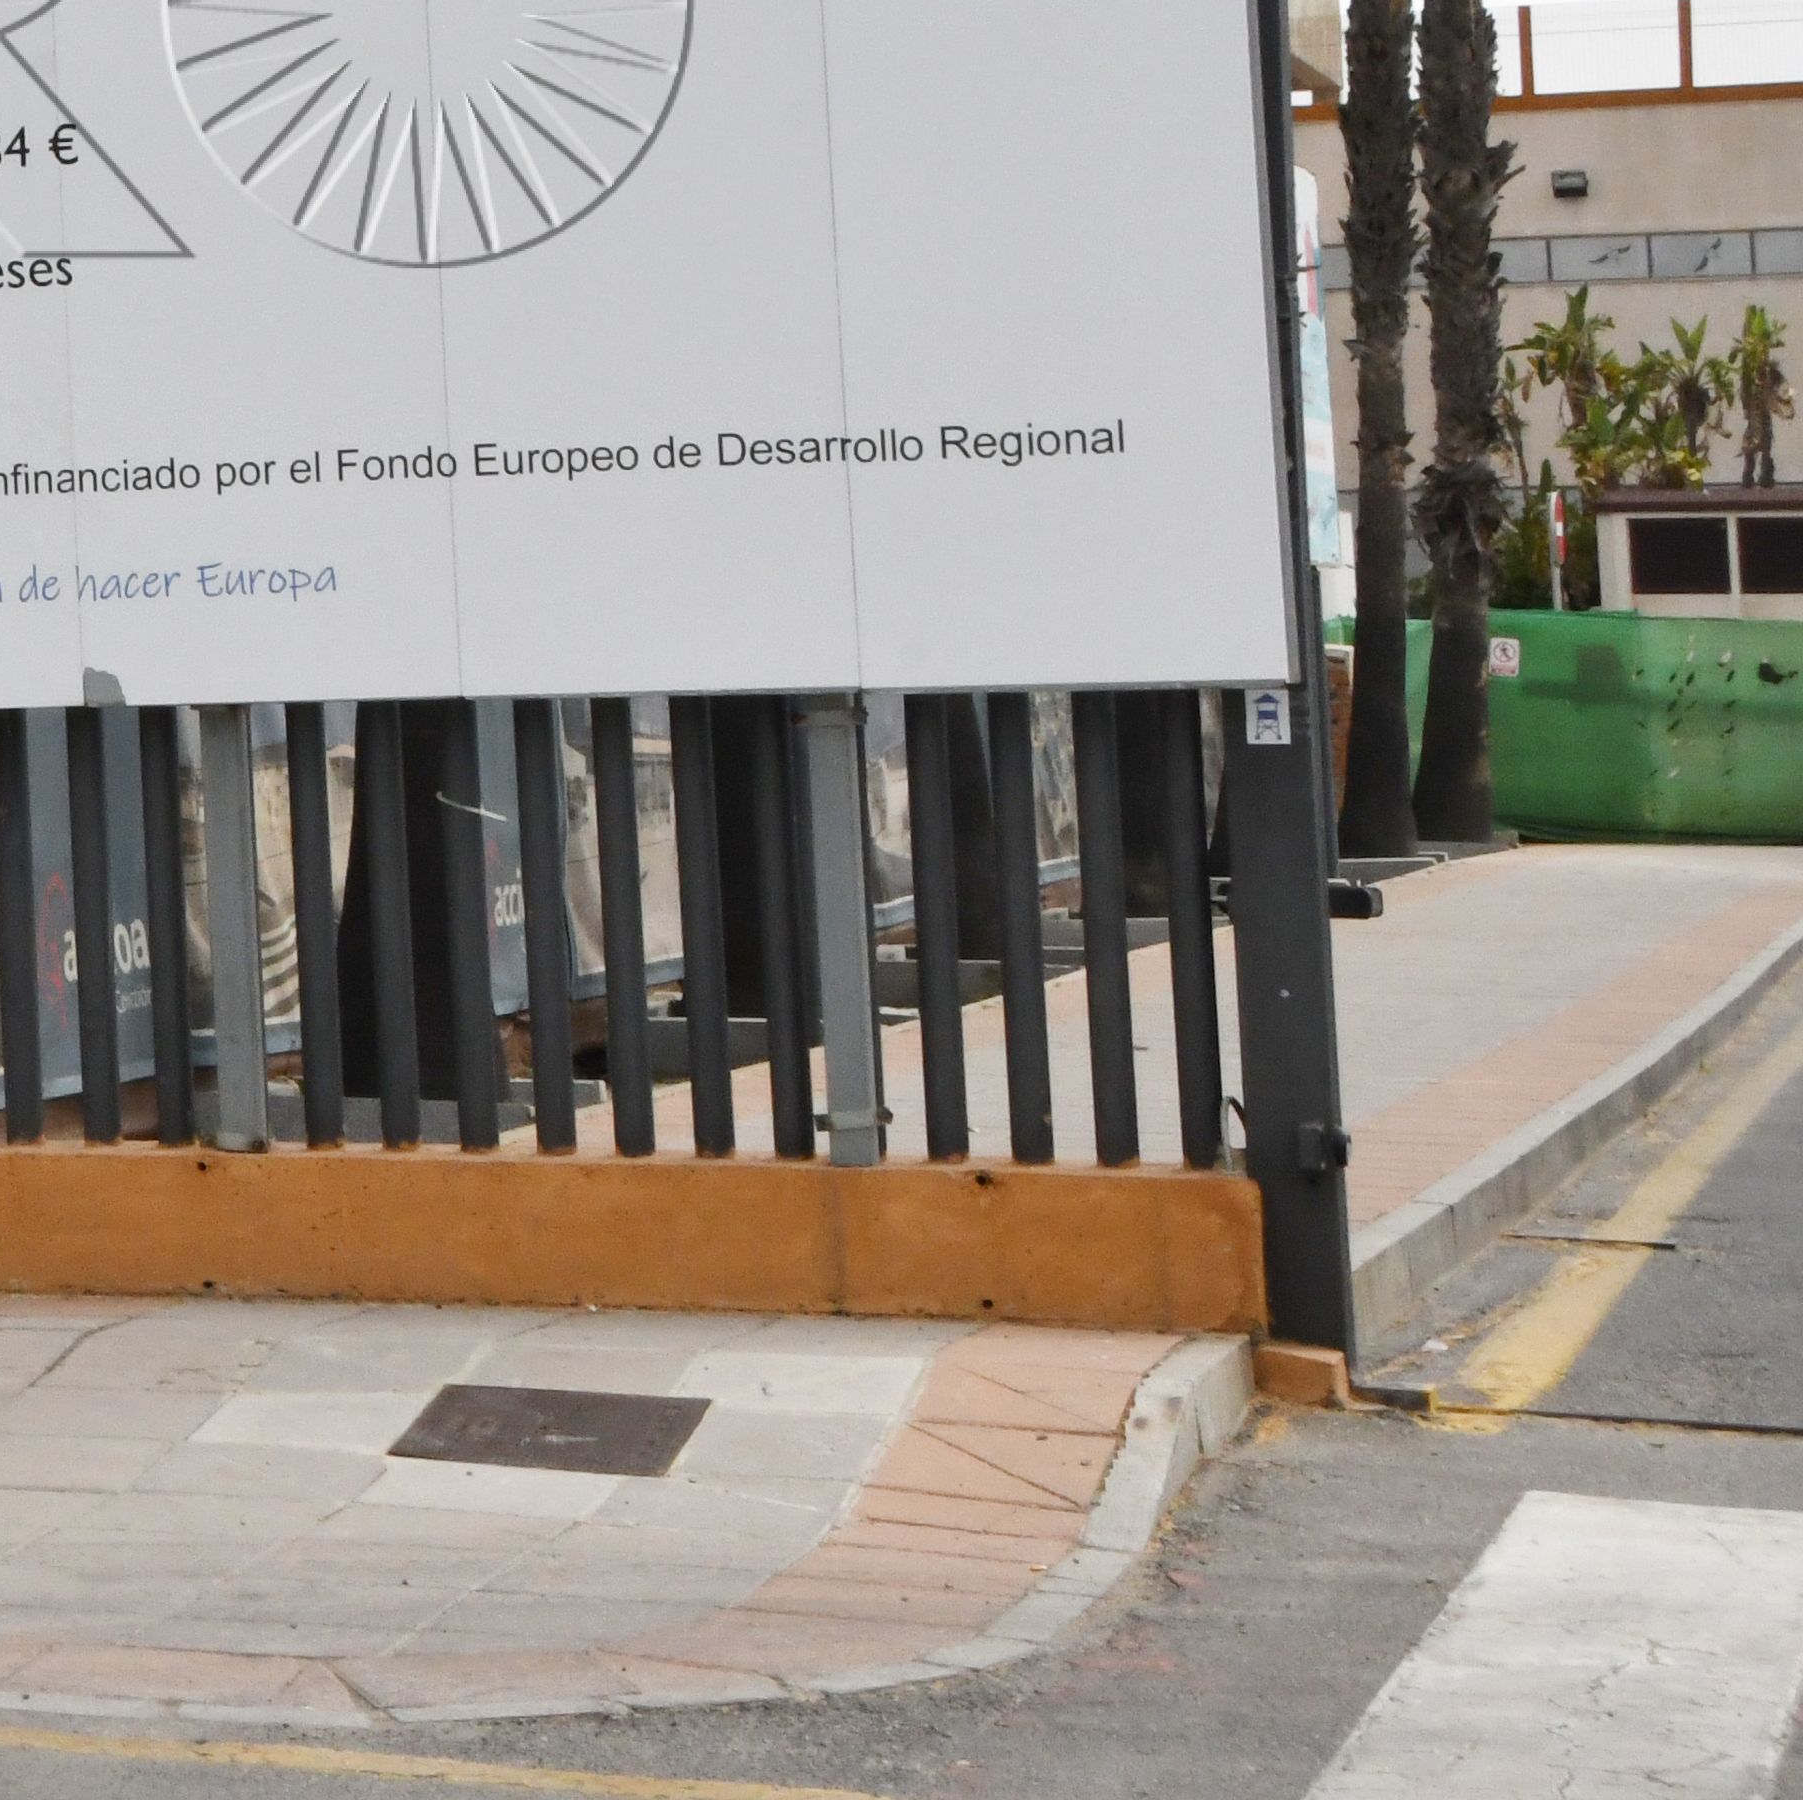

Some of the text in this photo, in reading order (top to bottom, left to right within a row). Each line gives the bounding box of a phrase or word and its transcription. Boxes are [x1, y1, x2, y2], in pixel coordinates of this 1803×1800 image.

[47, 123, 80, 165] €
[215, 455, 277, 495] por
[289, 451, 321, 484] el
[337, 445, 458, 483] Fondo
[473, 441, 640, 482] Europeo
[653, 435, 702, 469] de
[717, 428, 924, 468] Desarrollo
[940, 419, 1126, 469] Regional
[18, 565, 60, 601] de
[75, 565, 181, 602] hacer
[197, 563, 337, 601] Europa
